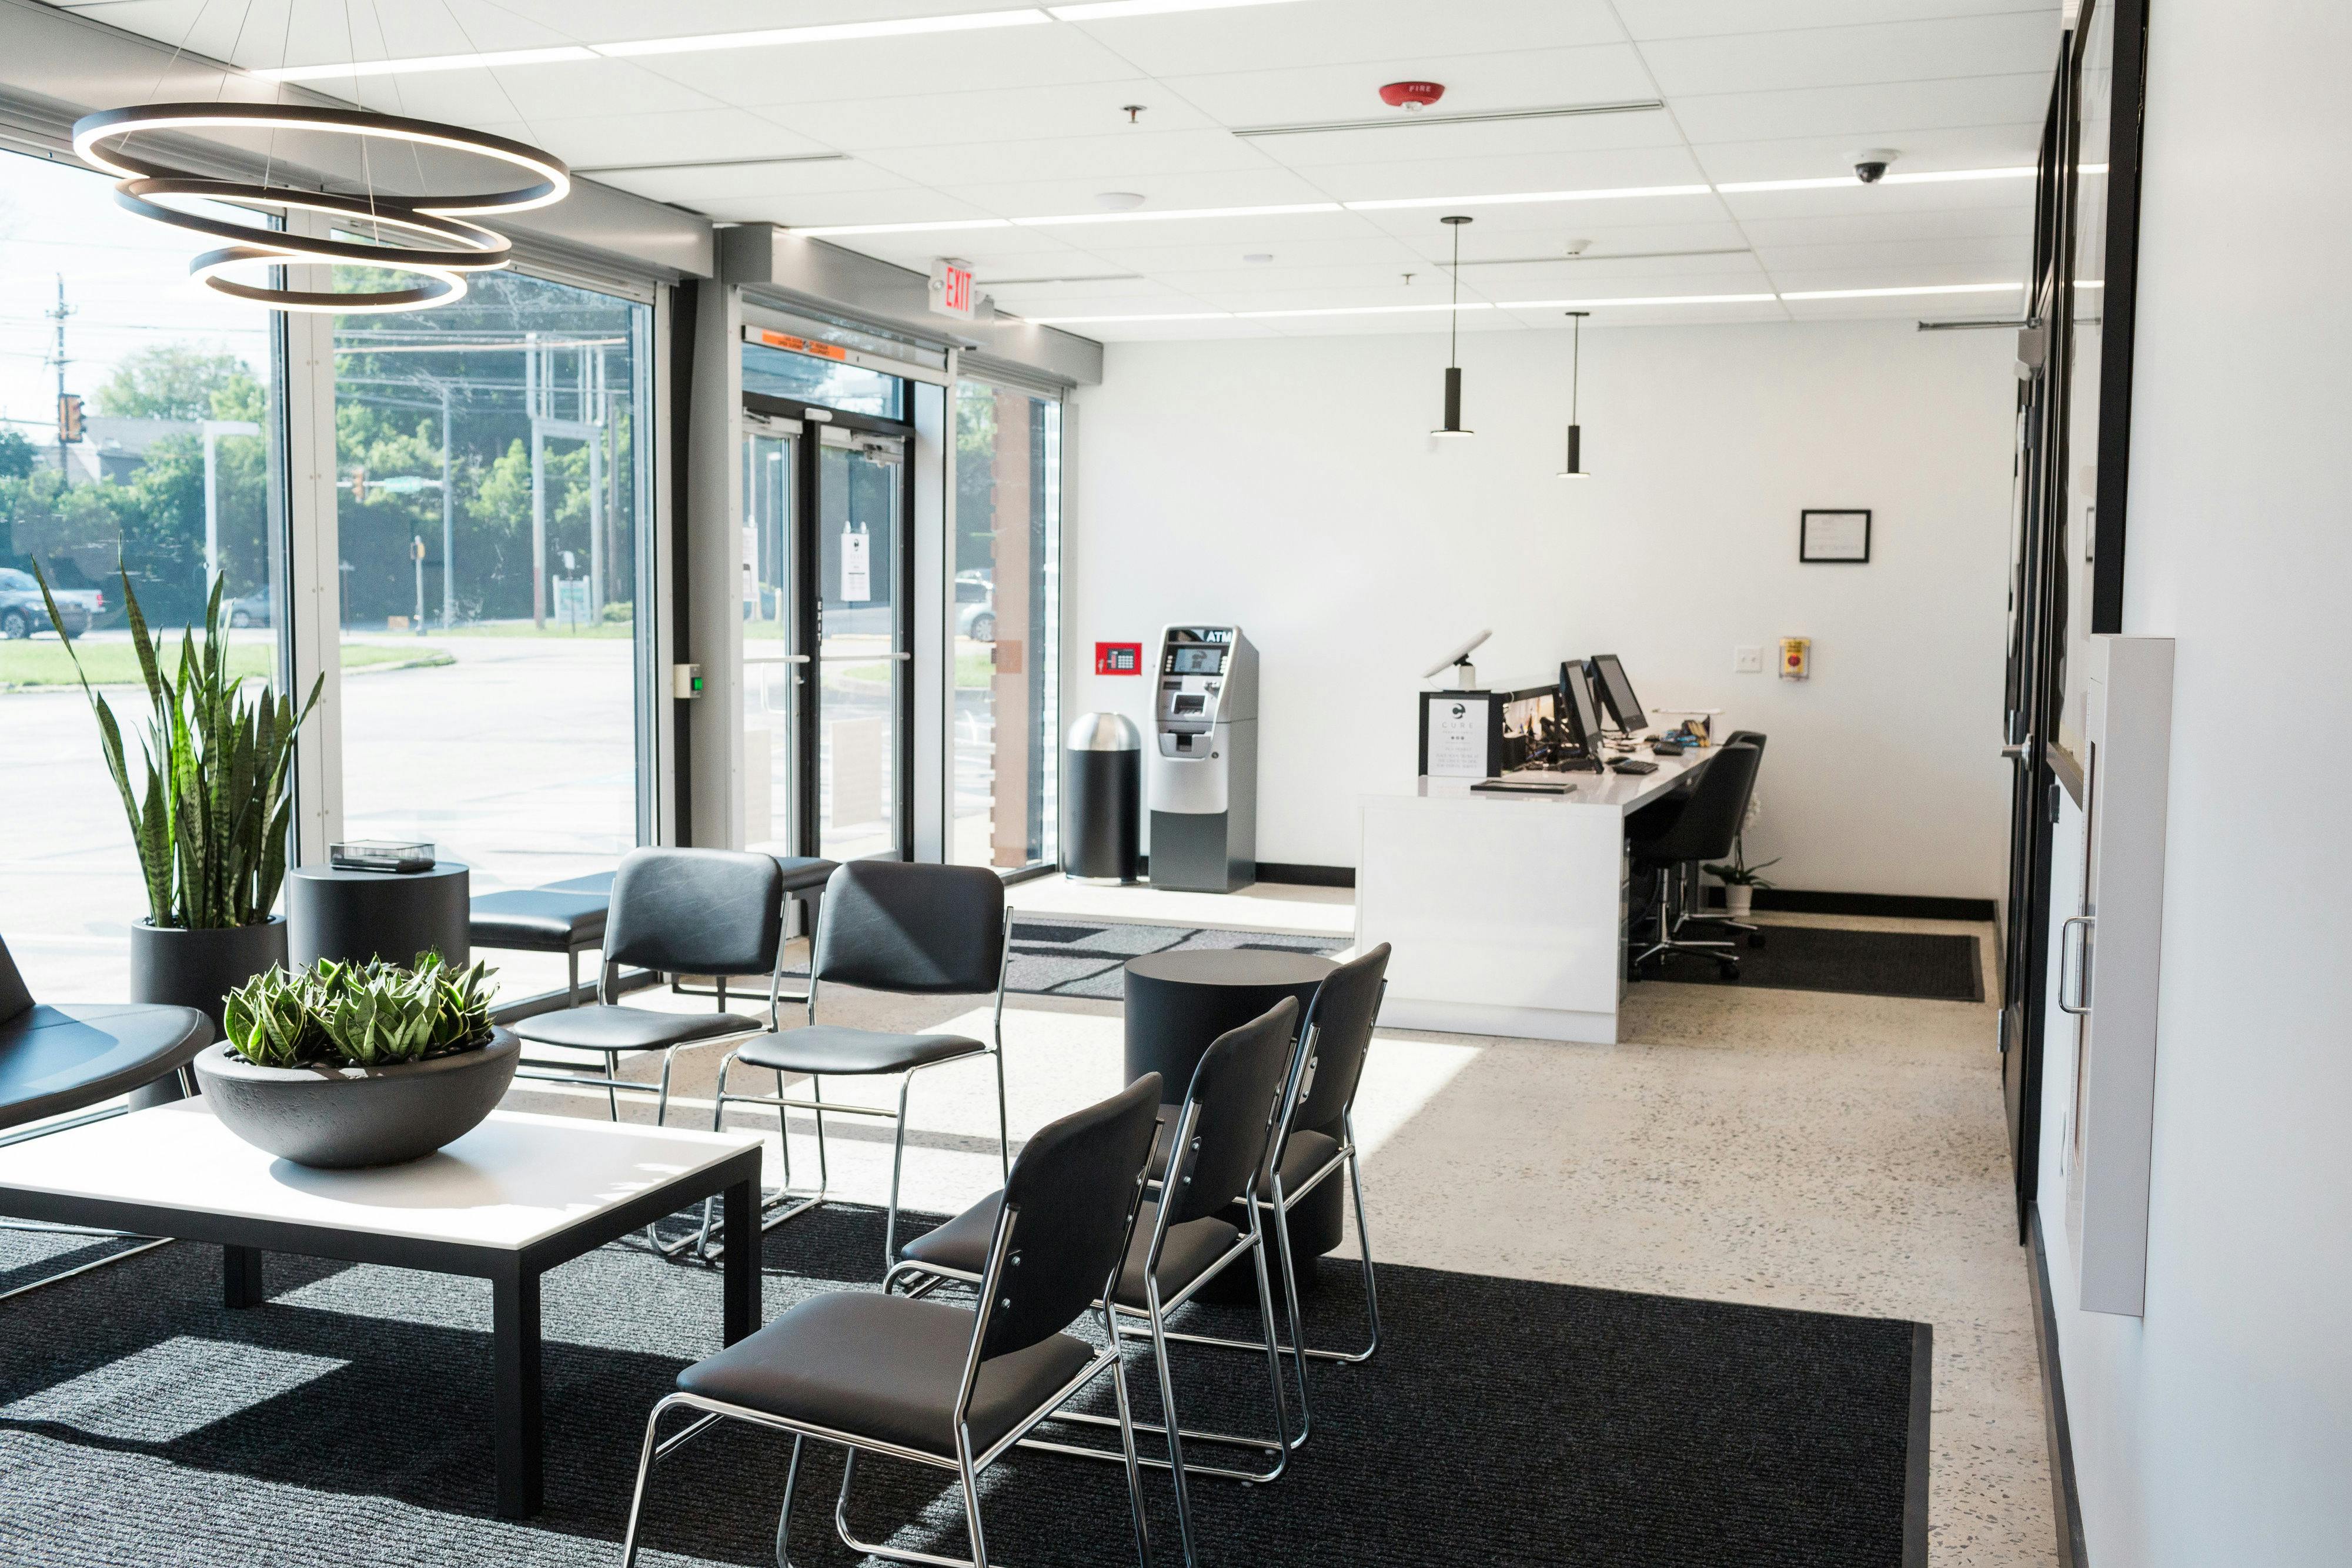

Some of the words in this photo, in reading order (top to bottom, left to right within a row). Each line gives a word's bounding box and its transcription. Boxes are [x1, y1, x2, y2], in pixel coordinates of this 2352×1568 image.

[1409, 85, 1431, 93] FIRE
[946, 266, 972, 312] EXIT
[1206, 630, 1232, 643] ATM
